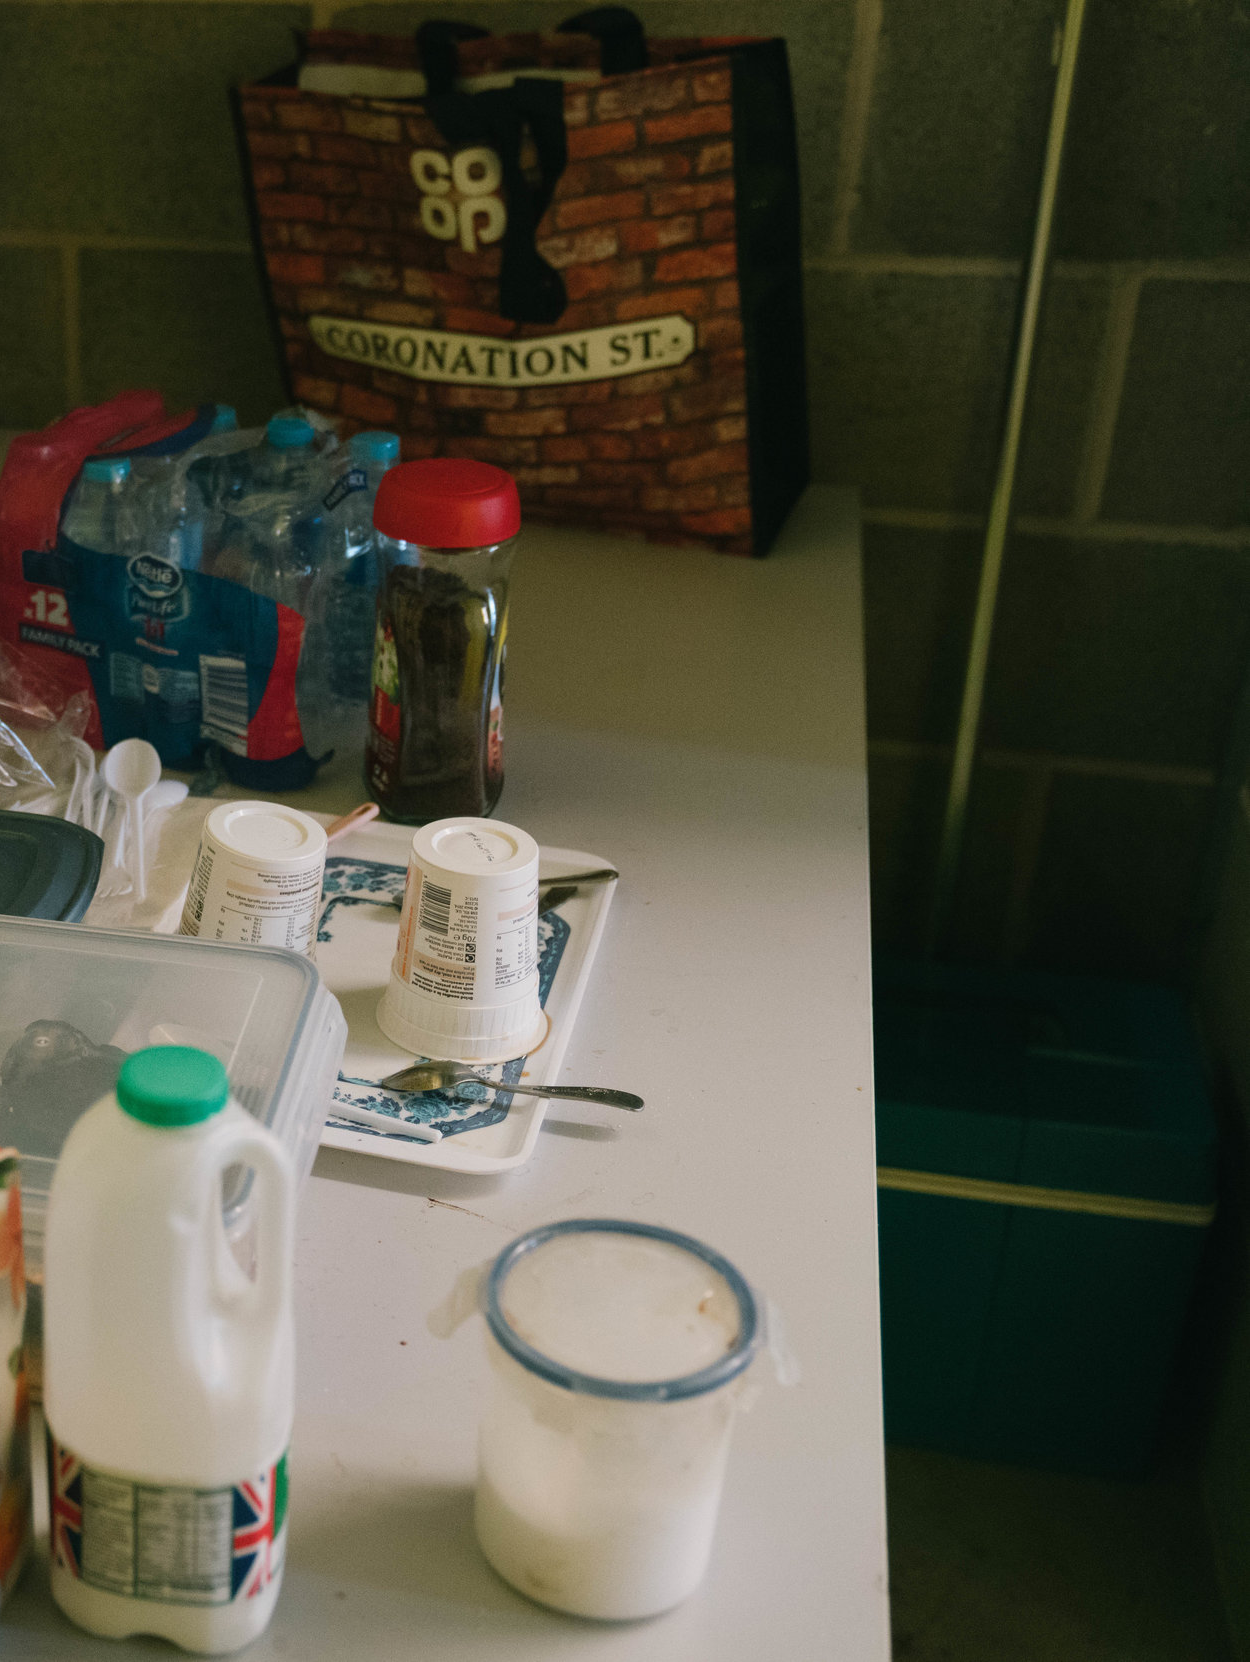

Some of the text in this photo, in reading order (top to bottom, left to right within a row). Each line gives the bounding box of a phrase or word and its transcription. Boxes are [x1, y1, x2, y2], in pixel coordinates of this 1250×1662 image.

[324, 325, 665, 379] CORONATION ST.
[21, 626, 101, 657] FAMILY PACK
[462, 934, 477, 943] 70g
